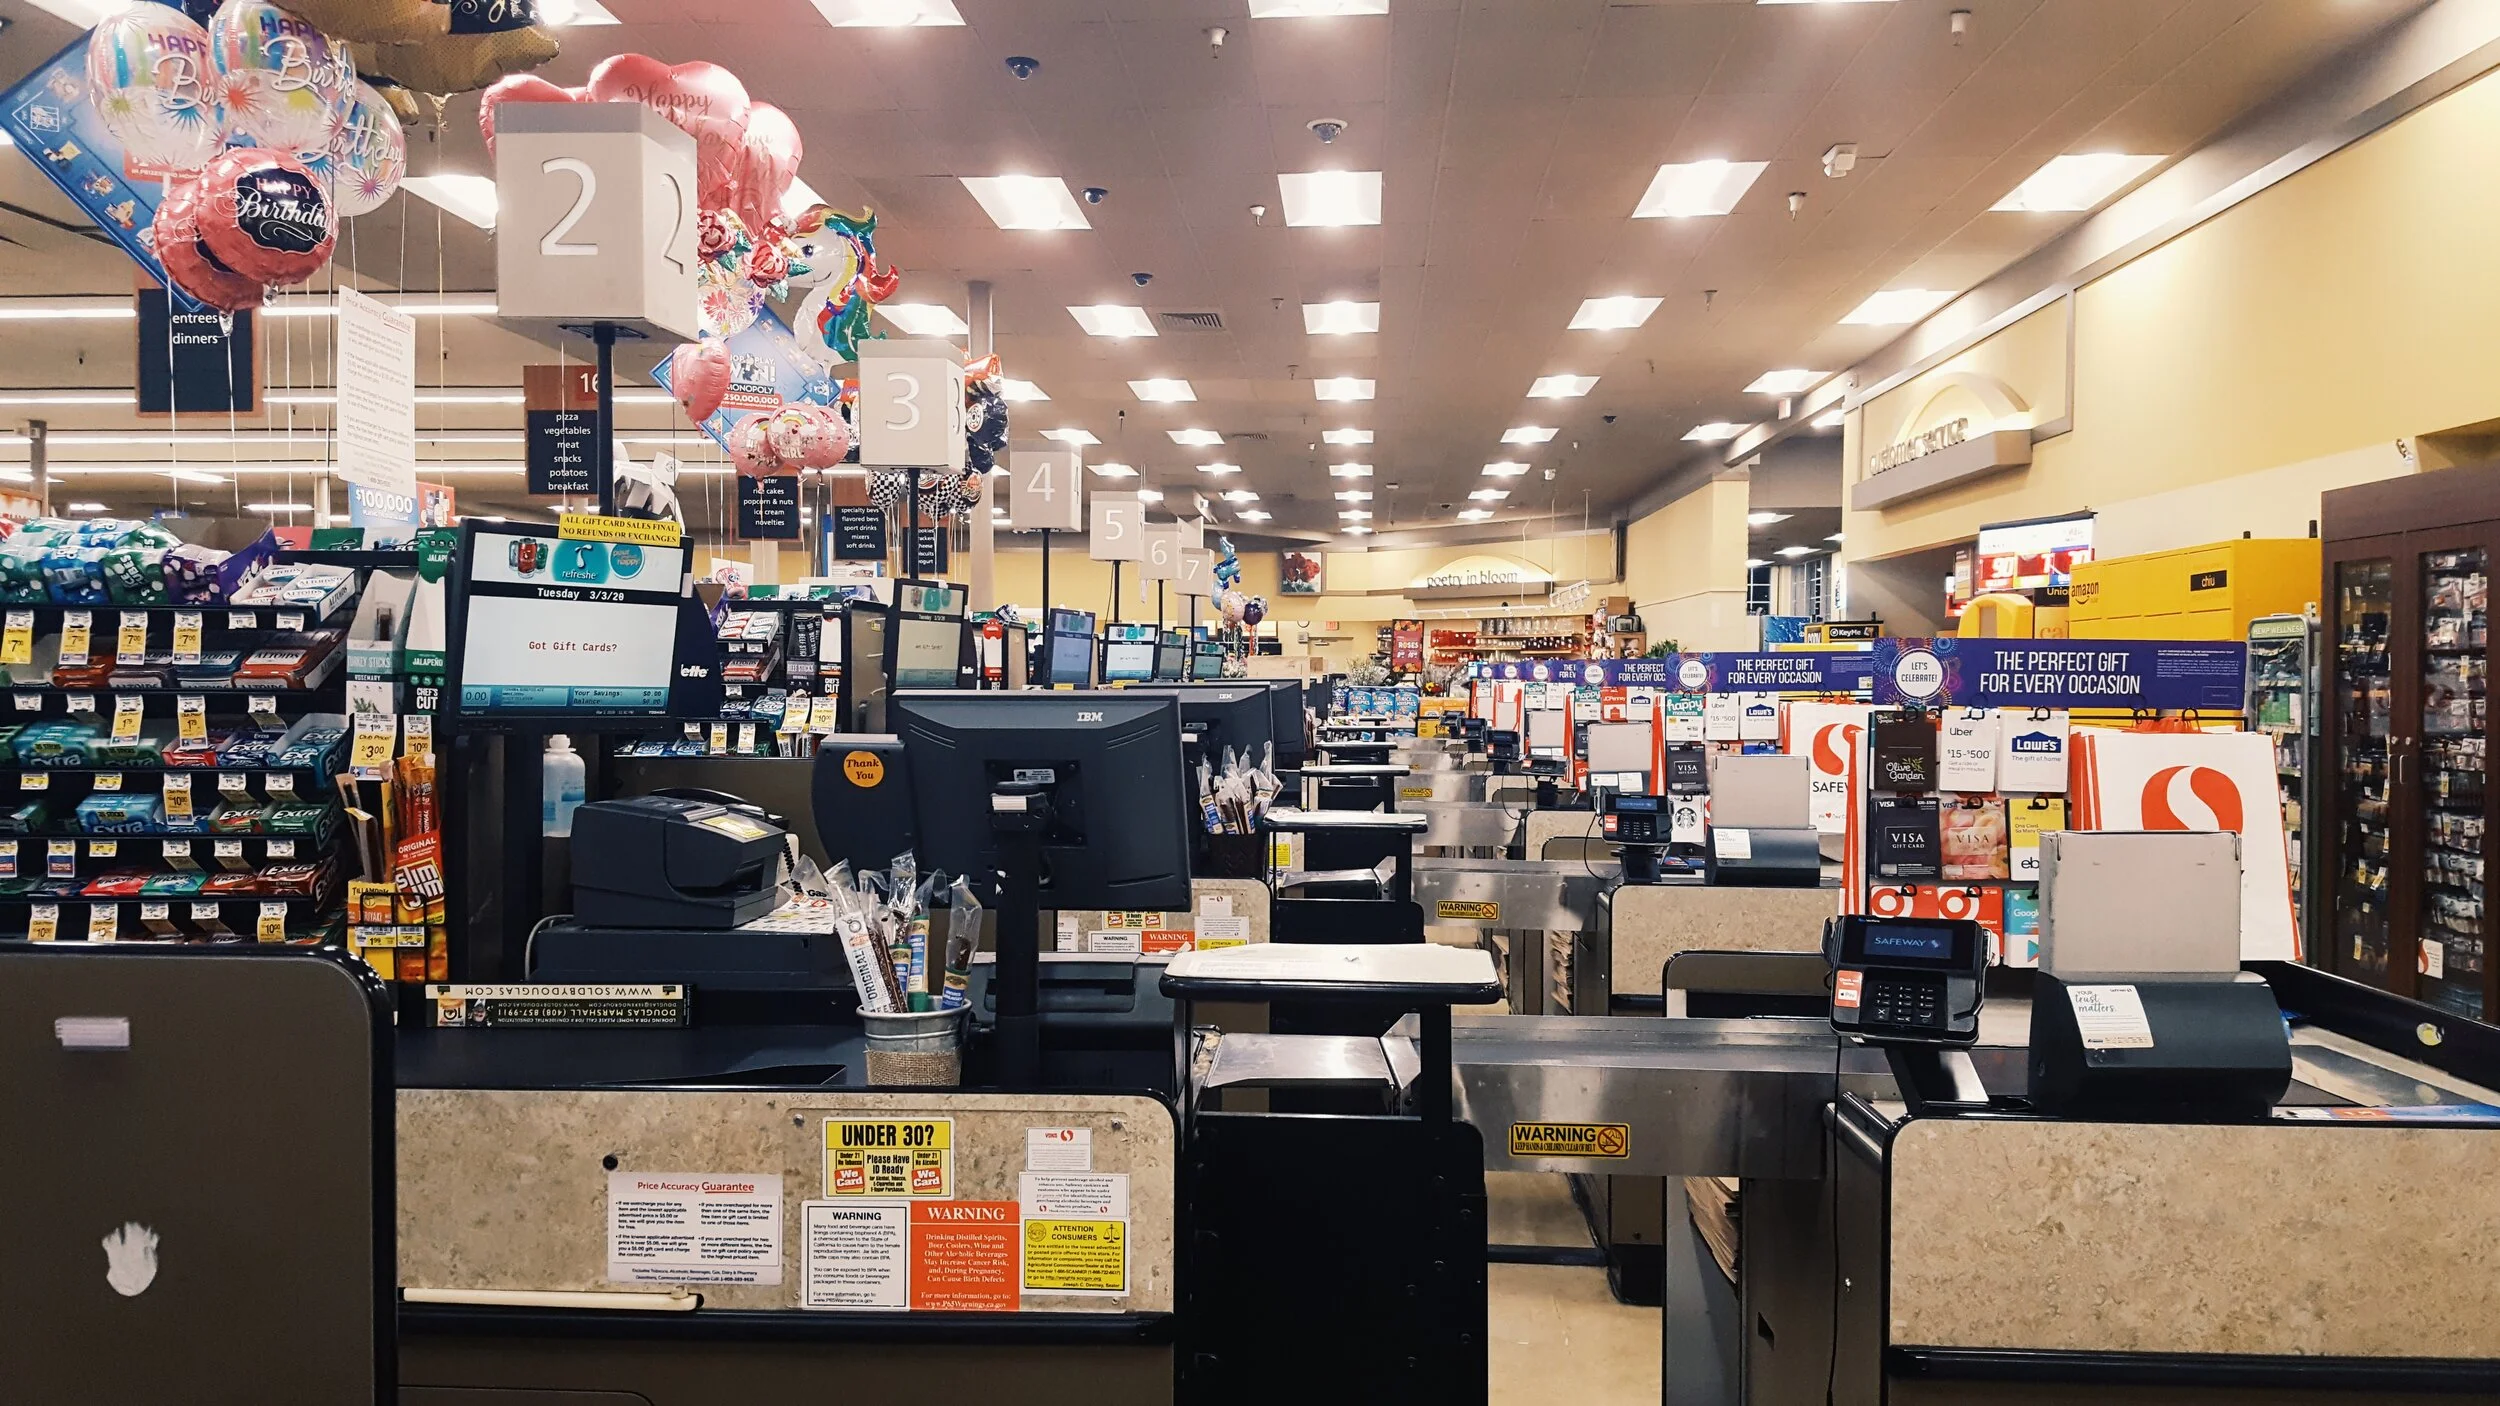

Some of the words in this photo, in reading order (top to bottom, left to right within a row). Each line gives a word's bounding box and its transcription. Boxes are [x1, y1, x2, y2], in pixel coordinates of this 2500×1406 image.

[254, 177, 312, 200] HAPPY
[234, 186, 331, 237] Birthday
[540, 157, 599, 256] 2
[172, 313, 218, 324] entrees
[172, 330, 218, 345] dinners
[885, 373, 920, 431] 3
[556, 413, 579, 423] pizza
[544, 424, 591, 437] vegetables
[557, 440, 580, 450] meat
[1869, 437, 1918, 477] customer
[1921, 416, 1969, 457] service
[554, 453, 582, 464] snacks
[549, 467, 589, 478] potatoes
[548, 481, 589, 492] breakfast
[1026, 462, 1056, 502] 4
[355, 489, 413, 515] $100,000
[841, 507, 865, 515] specialty
[564, 516, 579, 525] ALL
[582, 517, 602, 526] GIFT
[603, 518, 626, 528] CARD
[627, 520, 652, 530] SALES
[652, 522, 677, 533] FINAL
[755, 519, 785, 527] novelties
[1104, 510, 1124, 540] 5
[563, 527, 575, 535] NO
[576, 528, 613, 538] REFUNDS
[614, 530, 627, 539] OR
[627, 531, 677, 544] EXCHANGES
[1151, 539, 1167, 566] 6
[562, 569, 597, 580] refreshe
[1186, 559, 1200, 581] 7
[1427, 573, 1462, 589] poetry
[1466, 572, 1478, 586] in
[1480, 570, 1518, 584] bloom
[2201, 576, 2215, 588] chiu
[537, 587, 580, 600] Tuesday
[589, 590, 625, 601] 3/3/20
[2072, 582, 2099, 596] amazon
[1839, 629, 1861, 637] KeyMe
[2272, 625, 2304, 634] WELLNESS
[528, 641, 548, 651] Got
[552, 641, 577, 652] Gift
[582, 643, 618, 653] Cards?
[1398, 641, 1419, 649] ROSES
[1736, 659, 1753, 671] THE
[1755, 659, 1793, 671] PERFECT
[1795, 659, 1814, 671] GIFT
[1911, 661, 1928, 671] LET'S
[1994, 651, 2024, 671] THE
[2029, 651, 2095, 671] PERFECT
[2098, 652, 2130, 671] GIFT
[1624, 664, 1635, 672] THE
[1637, 664, 1664, 672] PERFECT
[1618, 673, 1630, 682] FOR
[1632, 673, 1652, 682] EVERY
[1728, 672, 1745, 684] FOR
[1747, 672, 1777, 684] EVERY
[1779, 672, 1822, 684] OCCASION
[1901, 673, 1938, 683] CELEBRATE!
[824, 684, 839, 693] CUT
[1980, 673, 2010, 693] FOR
[2014, 674, 2066, 694] EVERY
[2069, 674, 2141, 695] OCCASION
[416, 687, 438, 696] CHEF'S
[465, 691, 487, 701] 0.00
[416, 696, 438, 710] CUT
[1667, 696, 1704, 712] happy
[1077, 712, 1103, 722] IBM
[1950, 728, 1973, 736] Uber
[2017, 739, 2057, 751] LOWE'S
[845, 758, 880, 769] Thank
[1886, 761, 1911, 772] Olive
[855, 771, 875, 780] You
[1889, 771, 1925, 782] Garden
[1892, 833, 1925, 843] VISA
[1956, 834, 1989, 843] VISA
[398, 836, 437, 853] ORIGINAL
[1440, 903, 1482, 911] WARNING
[1149, 934, 1188, 942] WARNING
[1874, 937, 1927, 947] SAFEWAY
[854, 949, 879, 1000] ORIGINAL
[465, 986, 653, 997] WWW.SOLDBYDOUGLAS.COM
[2075, 993, 2100, 1003] trust
[542, 1008, 567, 1017] (408)
[842, 1125, 896, 1147] UNDER
[903, 1125, 934, 1147] 30?
[1515, 1127, 1596, 1142] WARNING
[866, 1155, 891, 1164] Please
[892, 1155, 910, 1164] Have
[840, 1169, 859, 1178] We
[873, 1165, 880, 1174] ID
[882, 1165, 904, 1175] Ready
[917, 1169, 936, 1178] We
[637, 1182, 659, 1190] Price
[661, 1182, 700, 1192] Accuracy
[702, 1182, 754, 1192] Guarantee
[836, 1176, 863, 1187] Card
[913, 1176, 941, 1187] Card
[832, 1212, 882, 1220] WARNING
[927, 1207, 1006, 1220] WARNING
